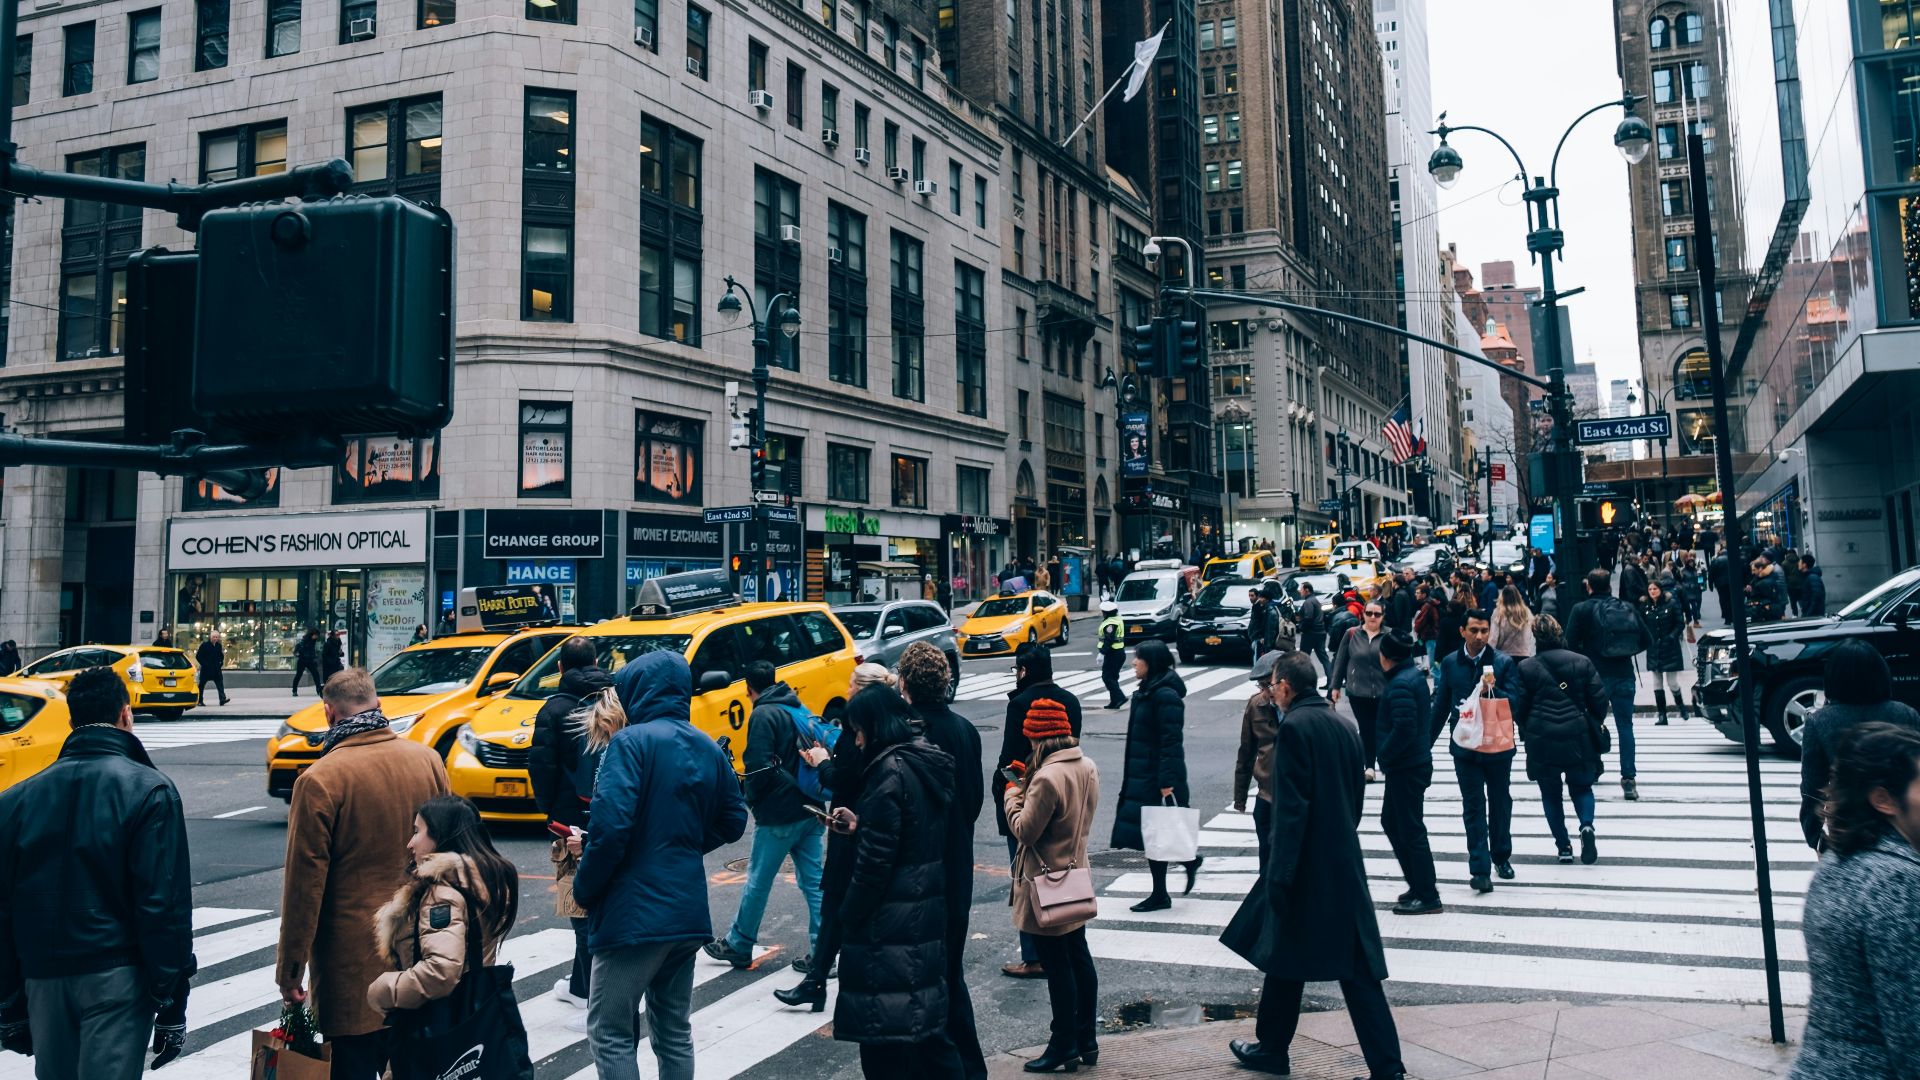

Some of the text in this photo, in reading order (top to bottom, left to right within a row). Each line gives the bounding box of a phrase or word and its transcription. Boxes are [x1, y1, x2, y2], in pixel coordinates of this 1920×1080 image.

[1583, 421, 1664, 438] East 42nd St
[707, 510, 750, 521] East 42nd St
[768, 510, 797, 520] Madison Ave
[489, 535, 600, 547] CHANGE GROUP
[633, 527, 719, 544] MONEY EXCHANGE
[767, 530, 780, 540] THE
[181, 529, 411, 555] COHEN'S FASHION OPTICAL
[508, 566, 571, 580] HANGE
[388, 587, 407, 597] Free
[479, 598, 507, 611] HARRY
[507, 596, 538, 610] POTTER
[379, 614, 416, 625] $250 OFF
